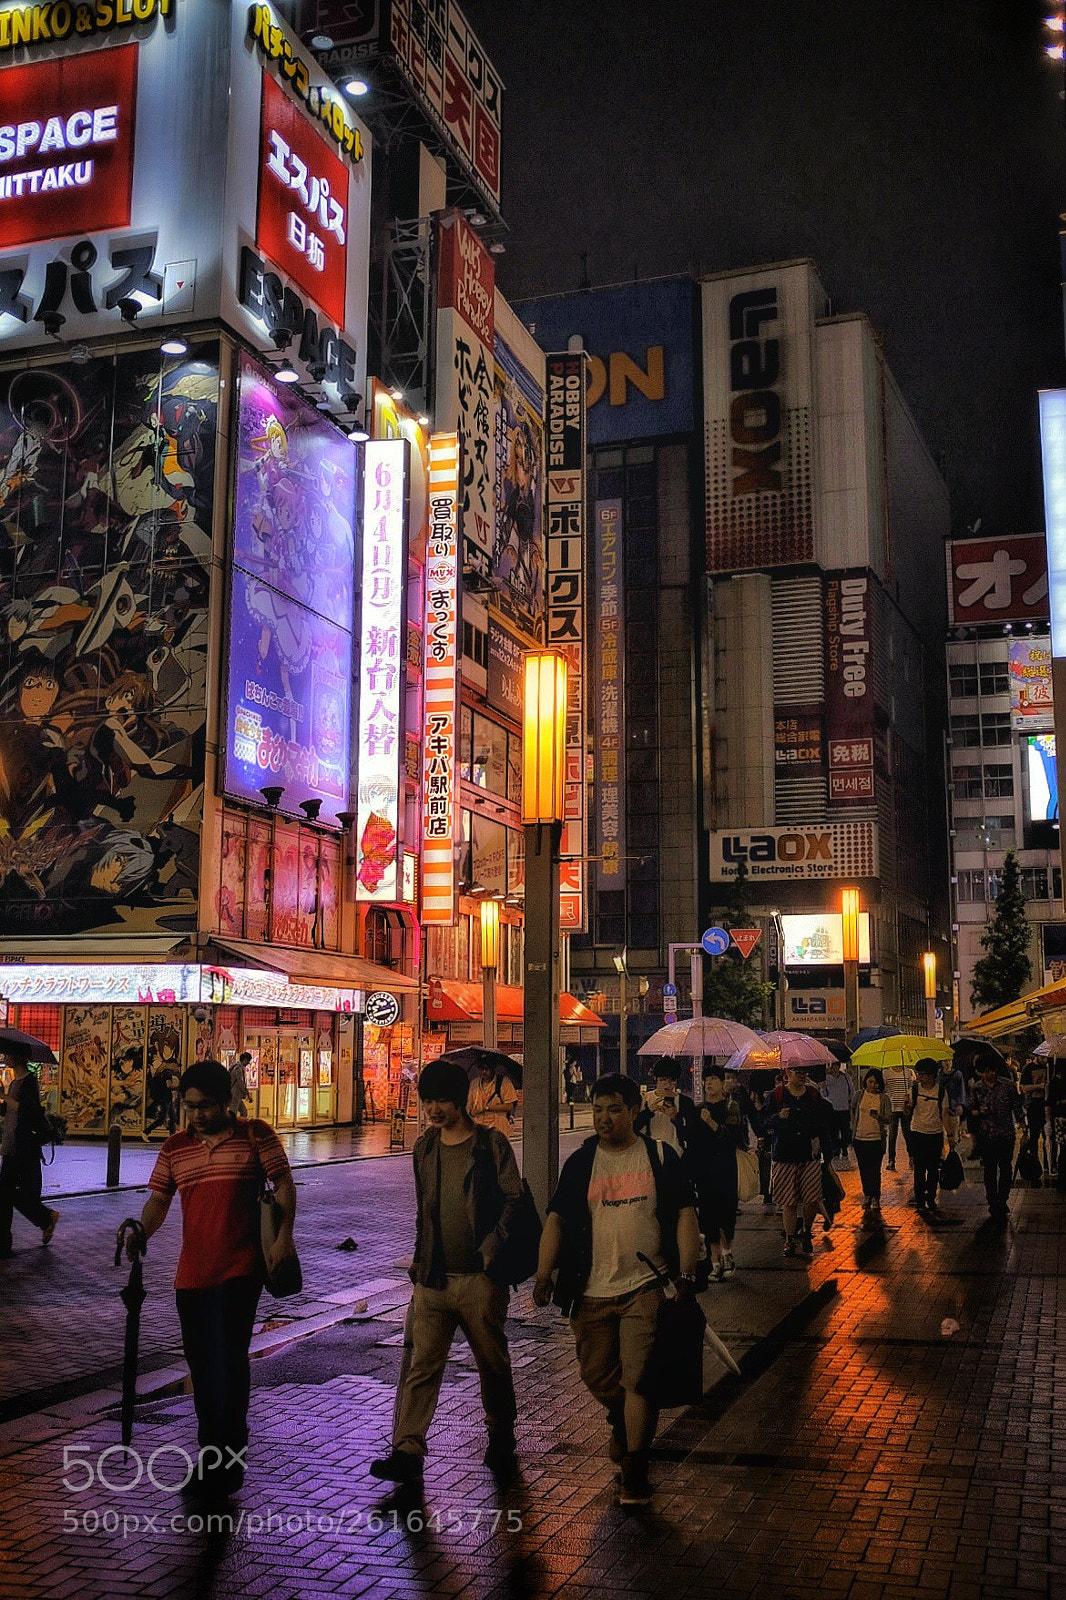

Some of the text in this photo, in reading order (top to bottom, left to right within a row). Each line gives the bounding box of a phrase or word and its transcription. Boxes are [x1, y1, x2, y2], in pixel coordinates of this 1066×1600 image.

[0, 160, 94, 200] ITTAKU
[265, 128, 346, 247] エスパス
[287, 211, 325, 273] 日拓
[549, 361, 565, 466] PARADISE
[565, 361, 581, 430] HOBBY
[430, 497, 454, 558] 買取り
[601, 510, 618, 521] 6F
[549, 504, 581, 638] ボークス
[430, 589, 455, 661] まっくす
[601, 619, 618, 630] 5F
[828, 580, 841, 672] Flagship Store
[840, 577, 870, 698] Duty Free
[364, 625, 399, 757] 新台入替
[600, 632, 618, 734] 冷蔵庫・洗濯機
[428, 714, 449, 838] アキバ駅前店
[601, 736, 618, 748] 4F
[832, 744, 869, 763] 免税
[832, 776, 871, 792] 면세점
[751, 864, 805, 875] Electronics
[806, 862, 834, 873] Store
